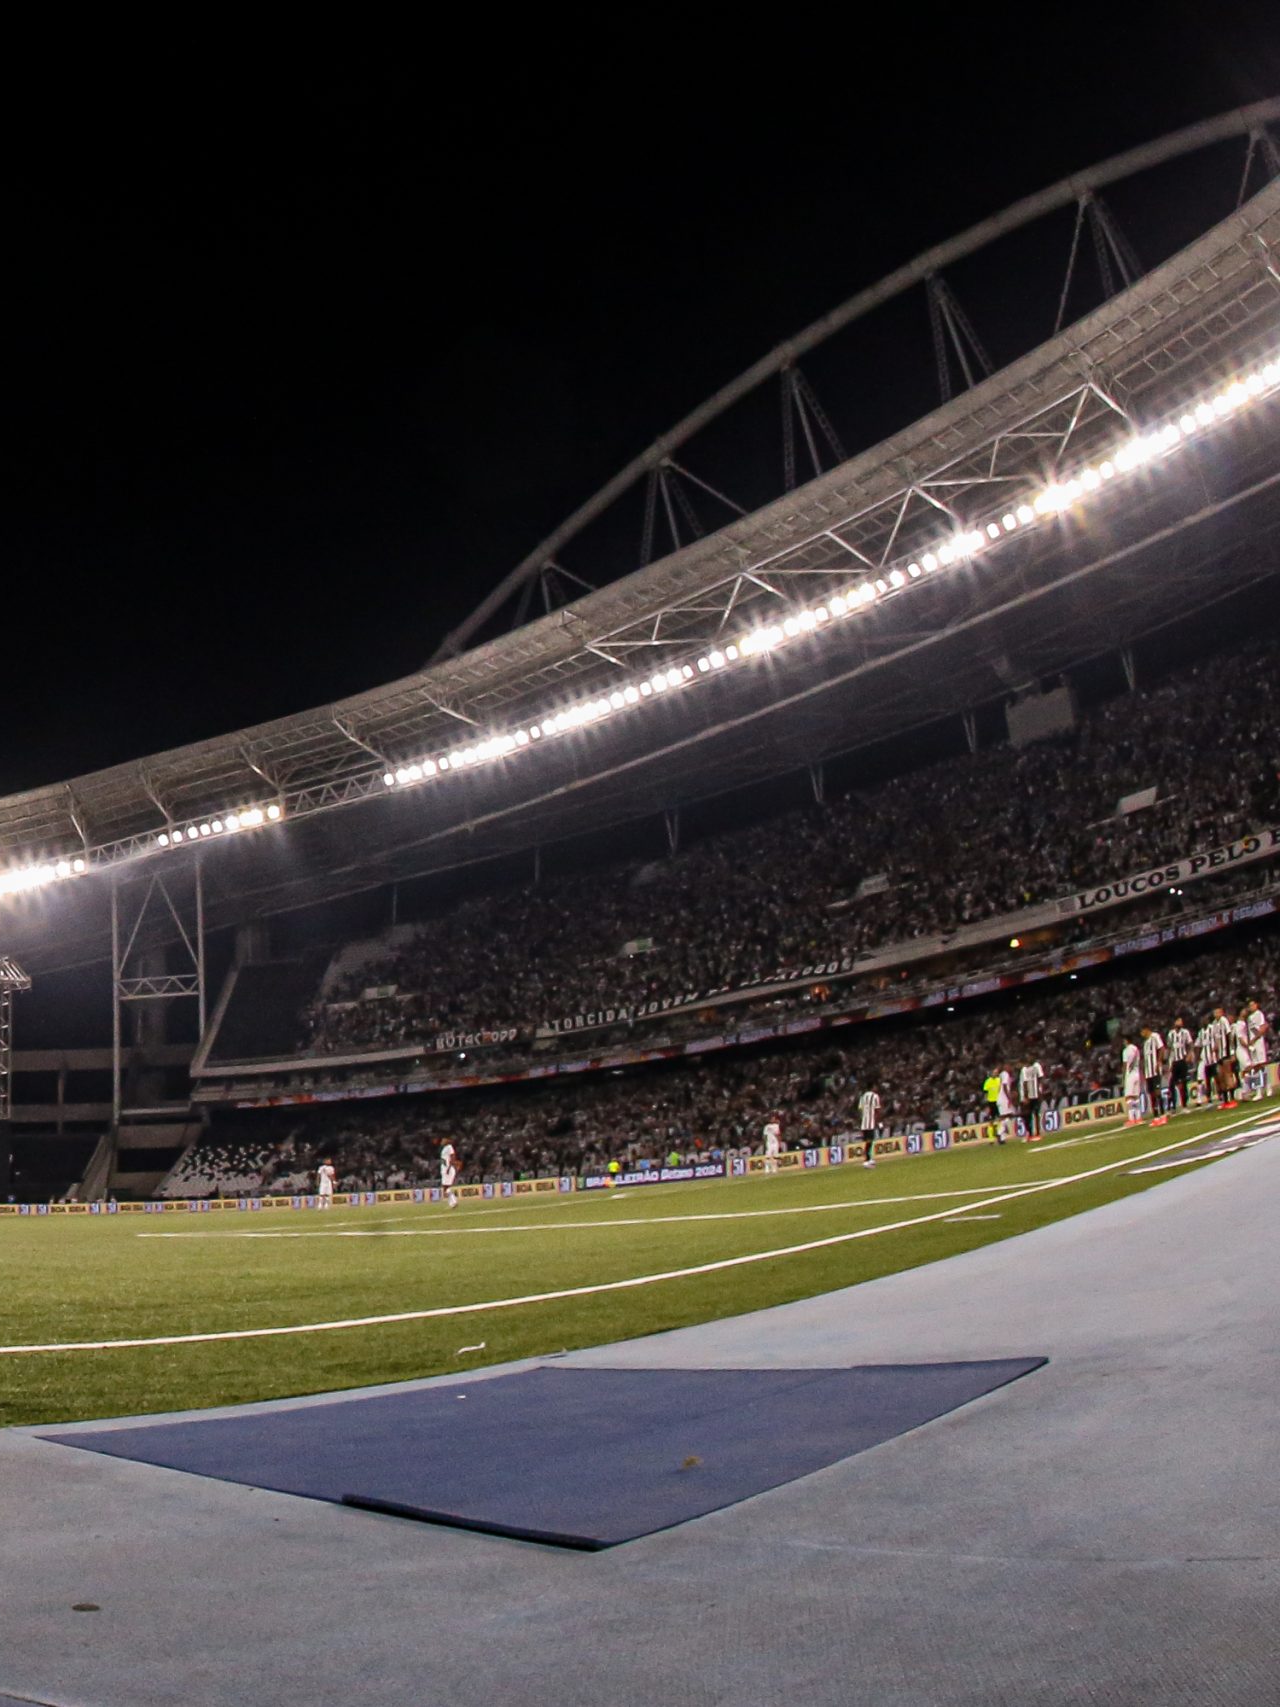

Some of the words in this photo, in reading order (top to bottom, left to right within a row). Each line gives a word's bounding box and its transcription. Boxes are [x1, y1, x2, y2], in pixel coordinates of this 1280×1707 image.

[1077, 866, 1180, 909] LOUCOS
[1189, 837, 1261, 875] PELO
[552, 1007, 628, 1032] TORCIDA
[1045, 1111, 1059, 1131] 51
[1064, 1108, 1090, 1125] BOA
[1094, 1102, 1125, 1118] IDEIA
[907, 1135, 921, 1153] 51
[934, 1130, 948, 1148] 51
[953, 1127, 978, 1143] BOA
[804, 1149, 817, 1168] 51
[830, 1147, 843, 1164] 51
[695, 1164, 723, 1177] 2024
[732, 1158, 745, 1175] 51
